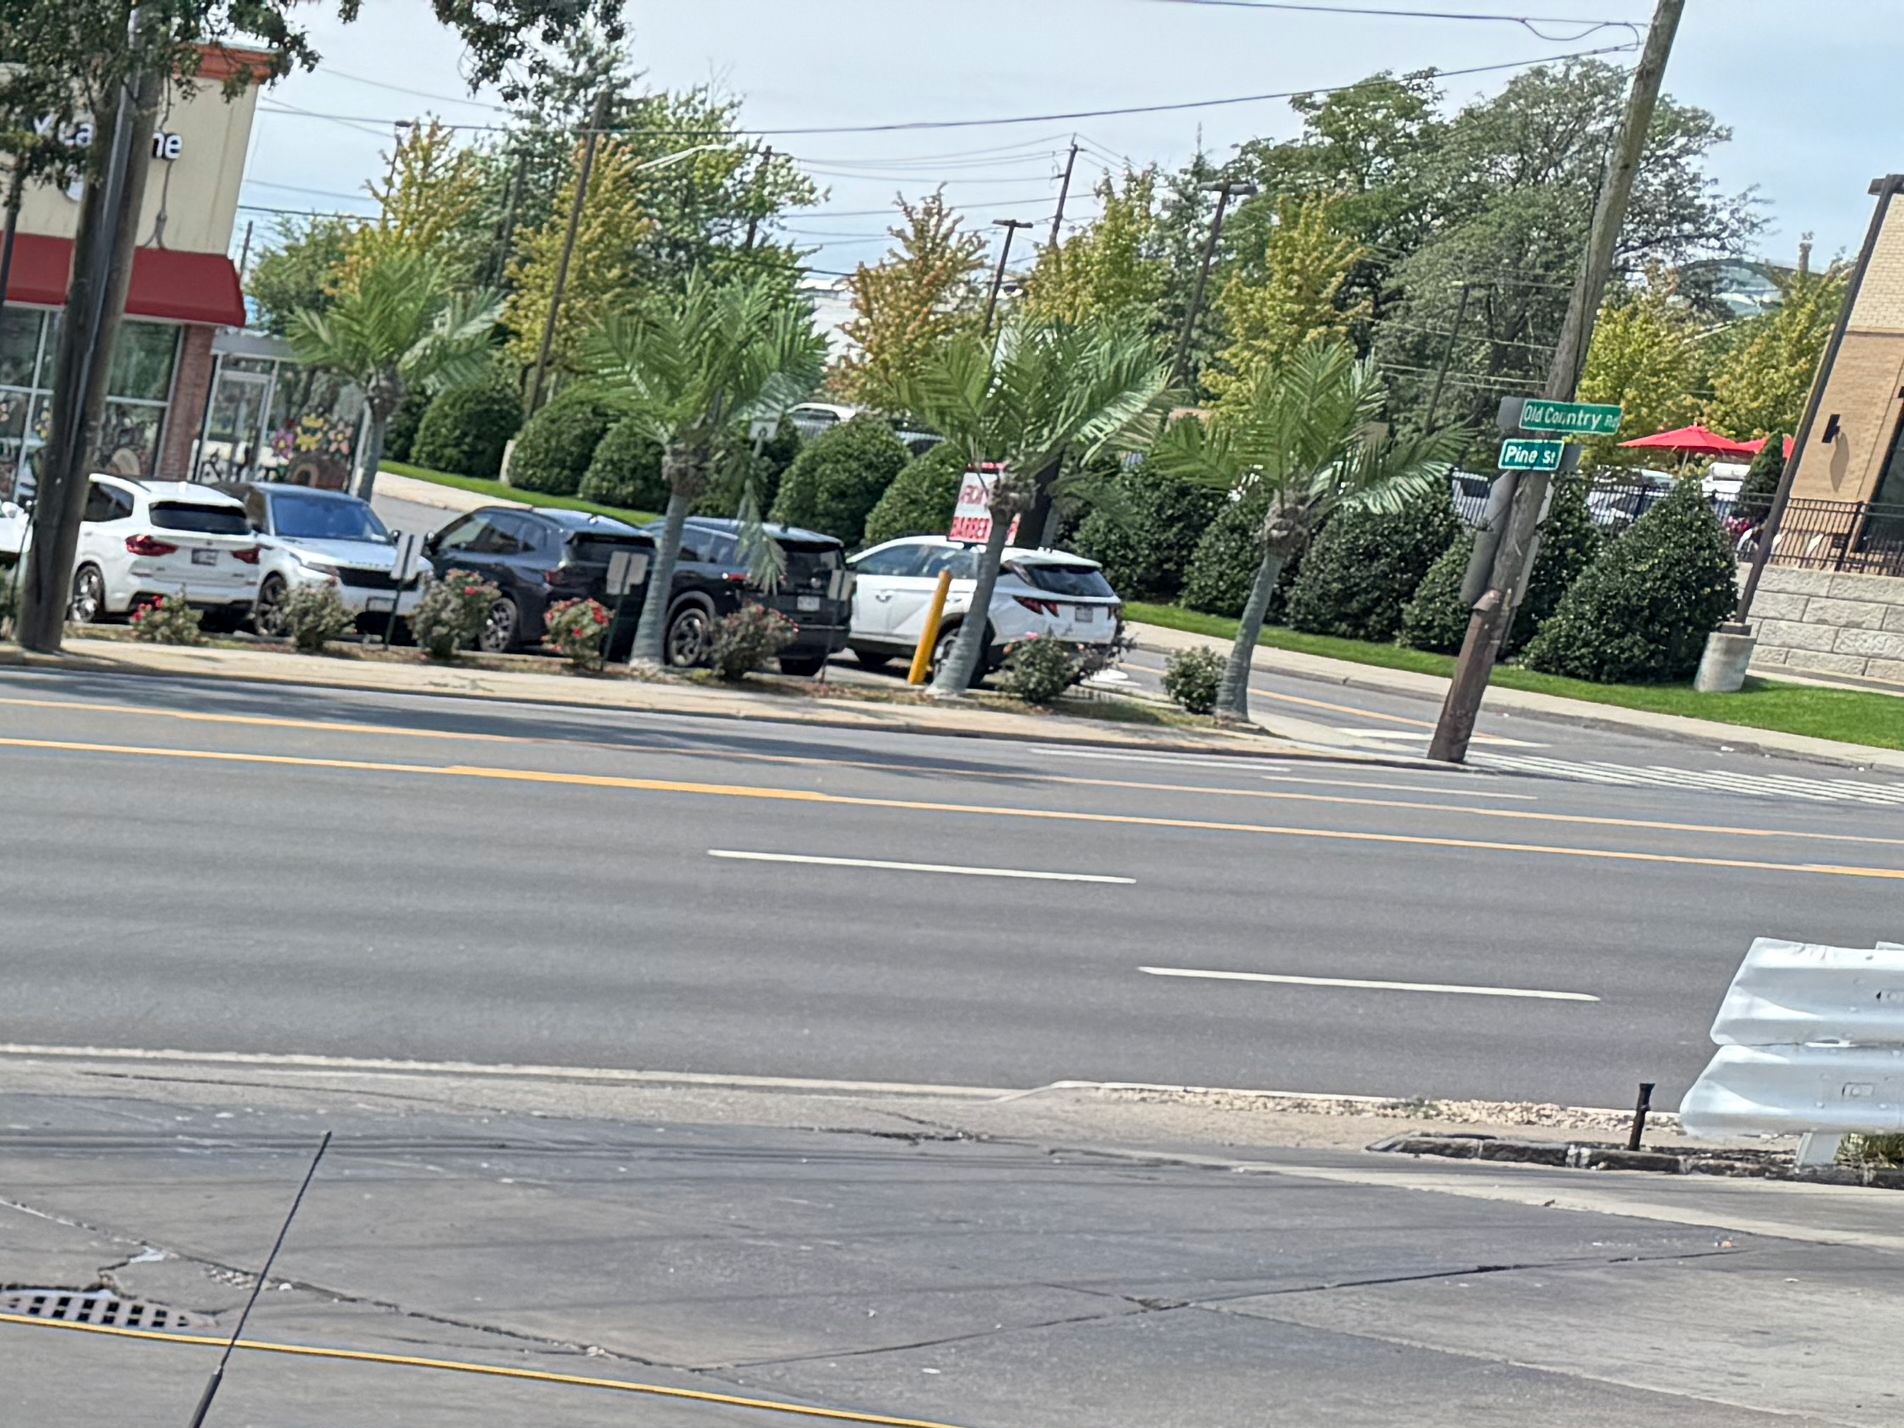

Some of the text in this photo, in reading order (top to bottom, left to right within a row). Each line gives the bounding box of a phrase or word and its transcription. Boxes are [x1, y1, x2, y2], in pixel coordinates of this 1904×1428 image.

[1524, 405, 1544, 422] Old
[1544, 406, 1602, 430] Country
[1504, 445, 1556, 464] Pine St
